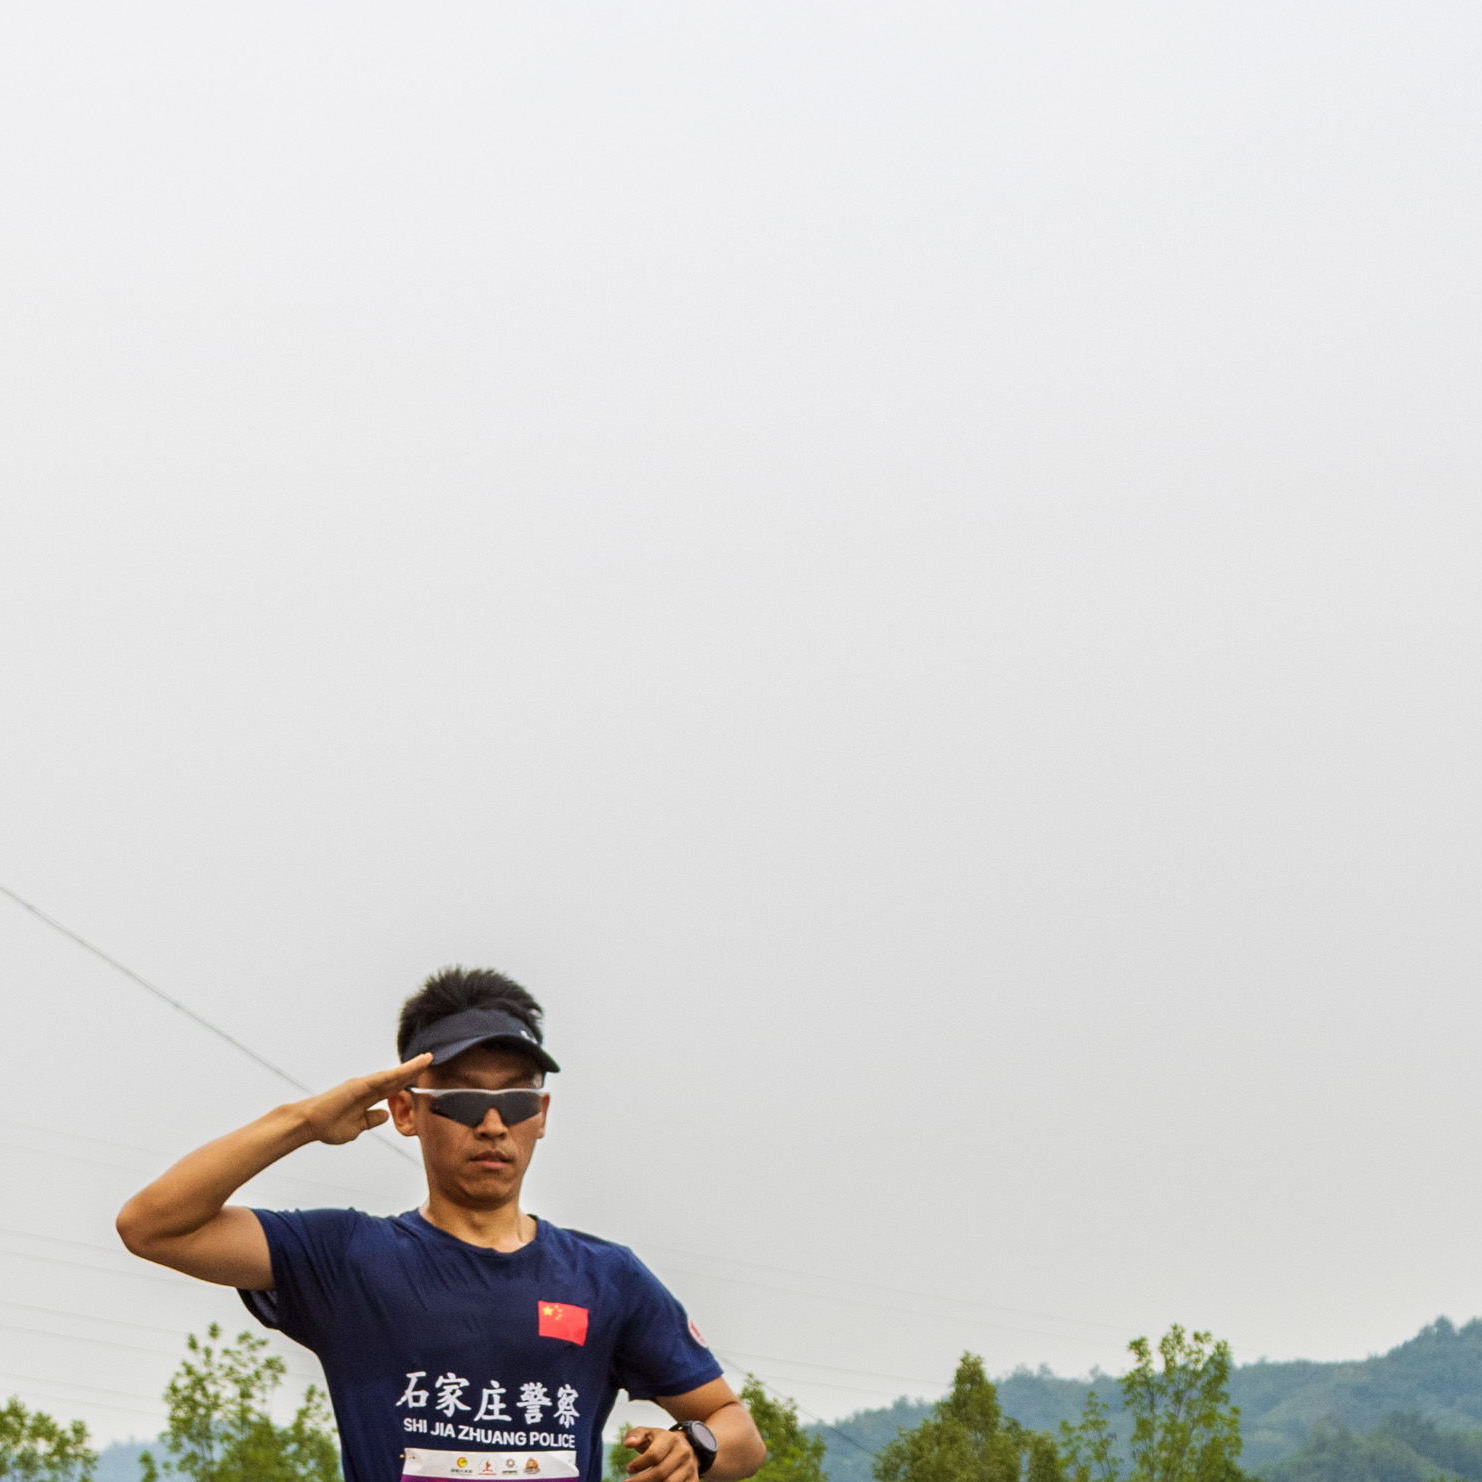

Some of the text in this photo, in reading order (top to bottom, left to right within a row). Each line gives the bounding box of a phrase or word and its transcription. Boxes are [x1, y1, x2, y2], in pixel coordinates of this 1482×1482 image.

[395, 1371, 581, 1428] 石家庄警察
[403, 1417, 576, 1449] SHI JIA ZHUANG POLICE
